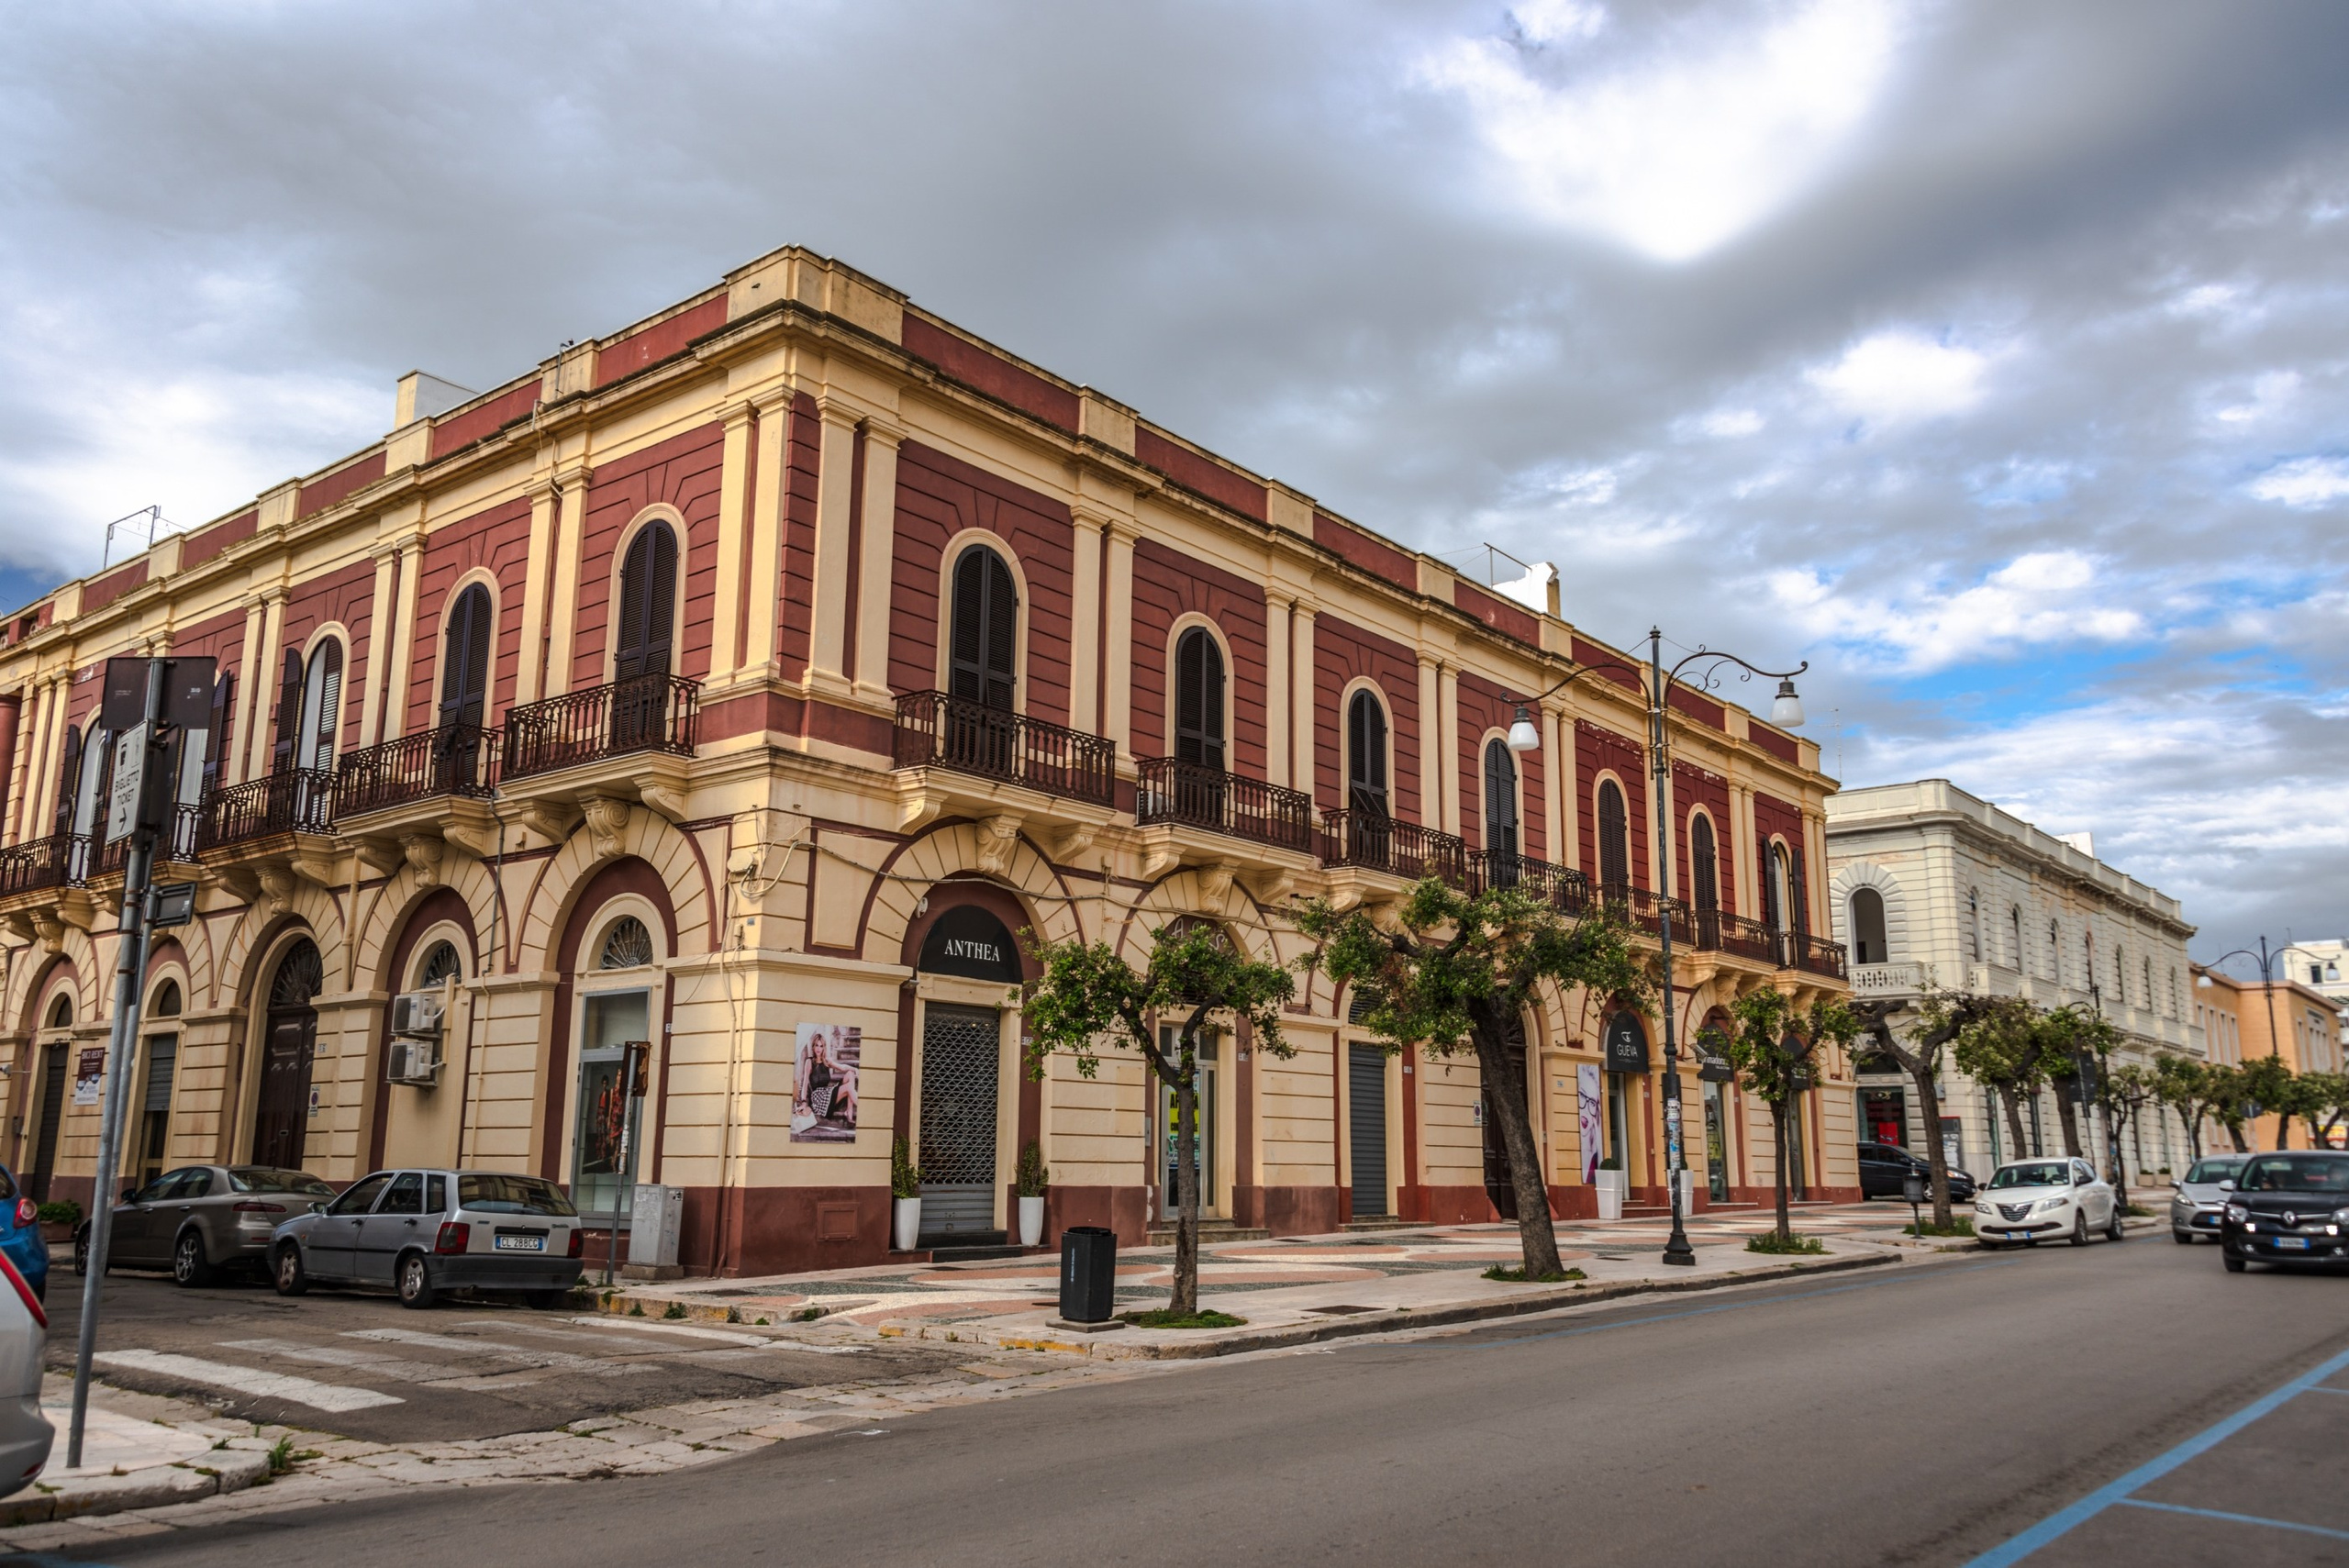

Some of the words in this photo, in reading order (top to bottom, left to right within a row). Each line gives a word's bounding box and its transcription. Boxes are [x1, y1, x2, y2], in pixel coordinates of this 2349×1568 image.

[117, 788, 135, 806] TICKET
[944, 939, 1000, 962] ANTHEA
[1616, 1043, 1639, 1058] GUEVA
